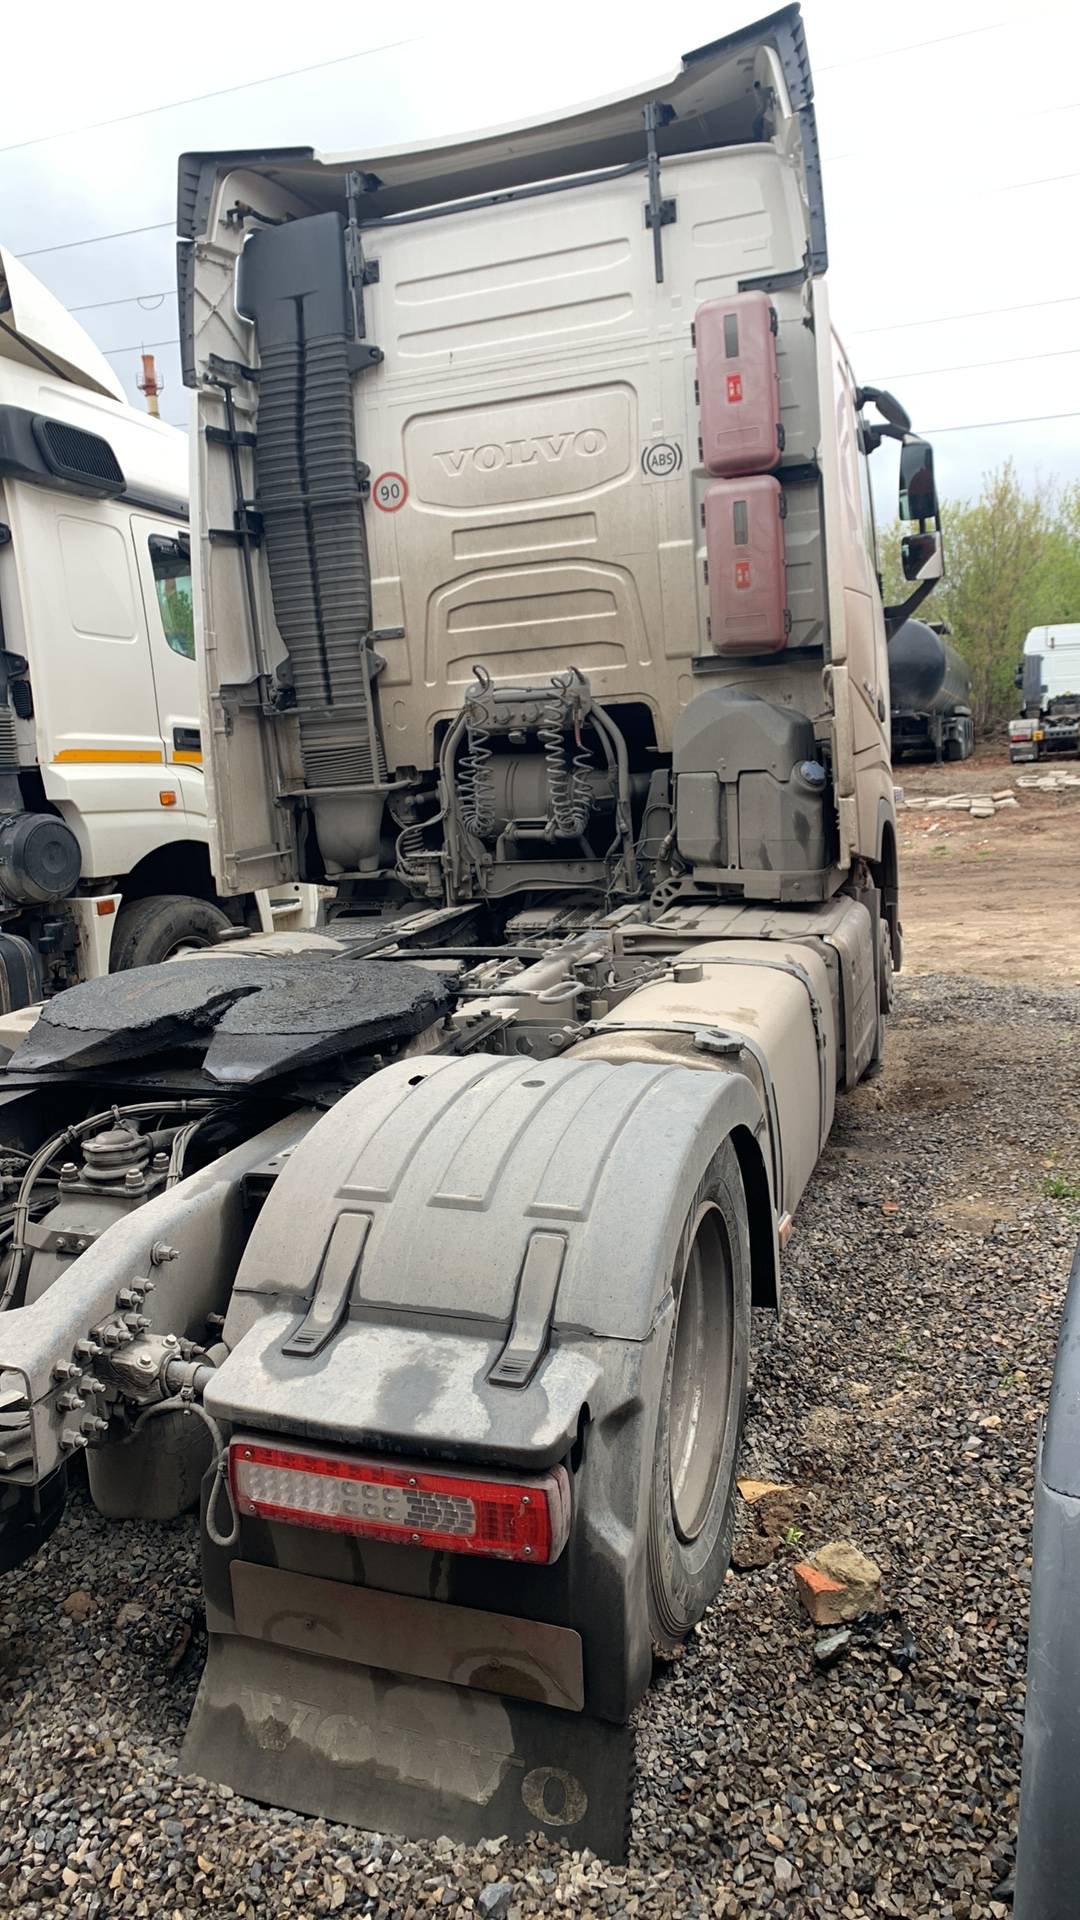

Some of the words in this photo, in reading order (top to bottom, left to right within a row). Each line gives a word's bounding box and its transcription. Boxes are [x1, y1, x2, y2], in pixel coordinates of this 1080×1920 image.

[433, 428, 608, 477] VOLVO
[651, 452, 673, 466] ABS
[380, 483, 400, 501] 90
